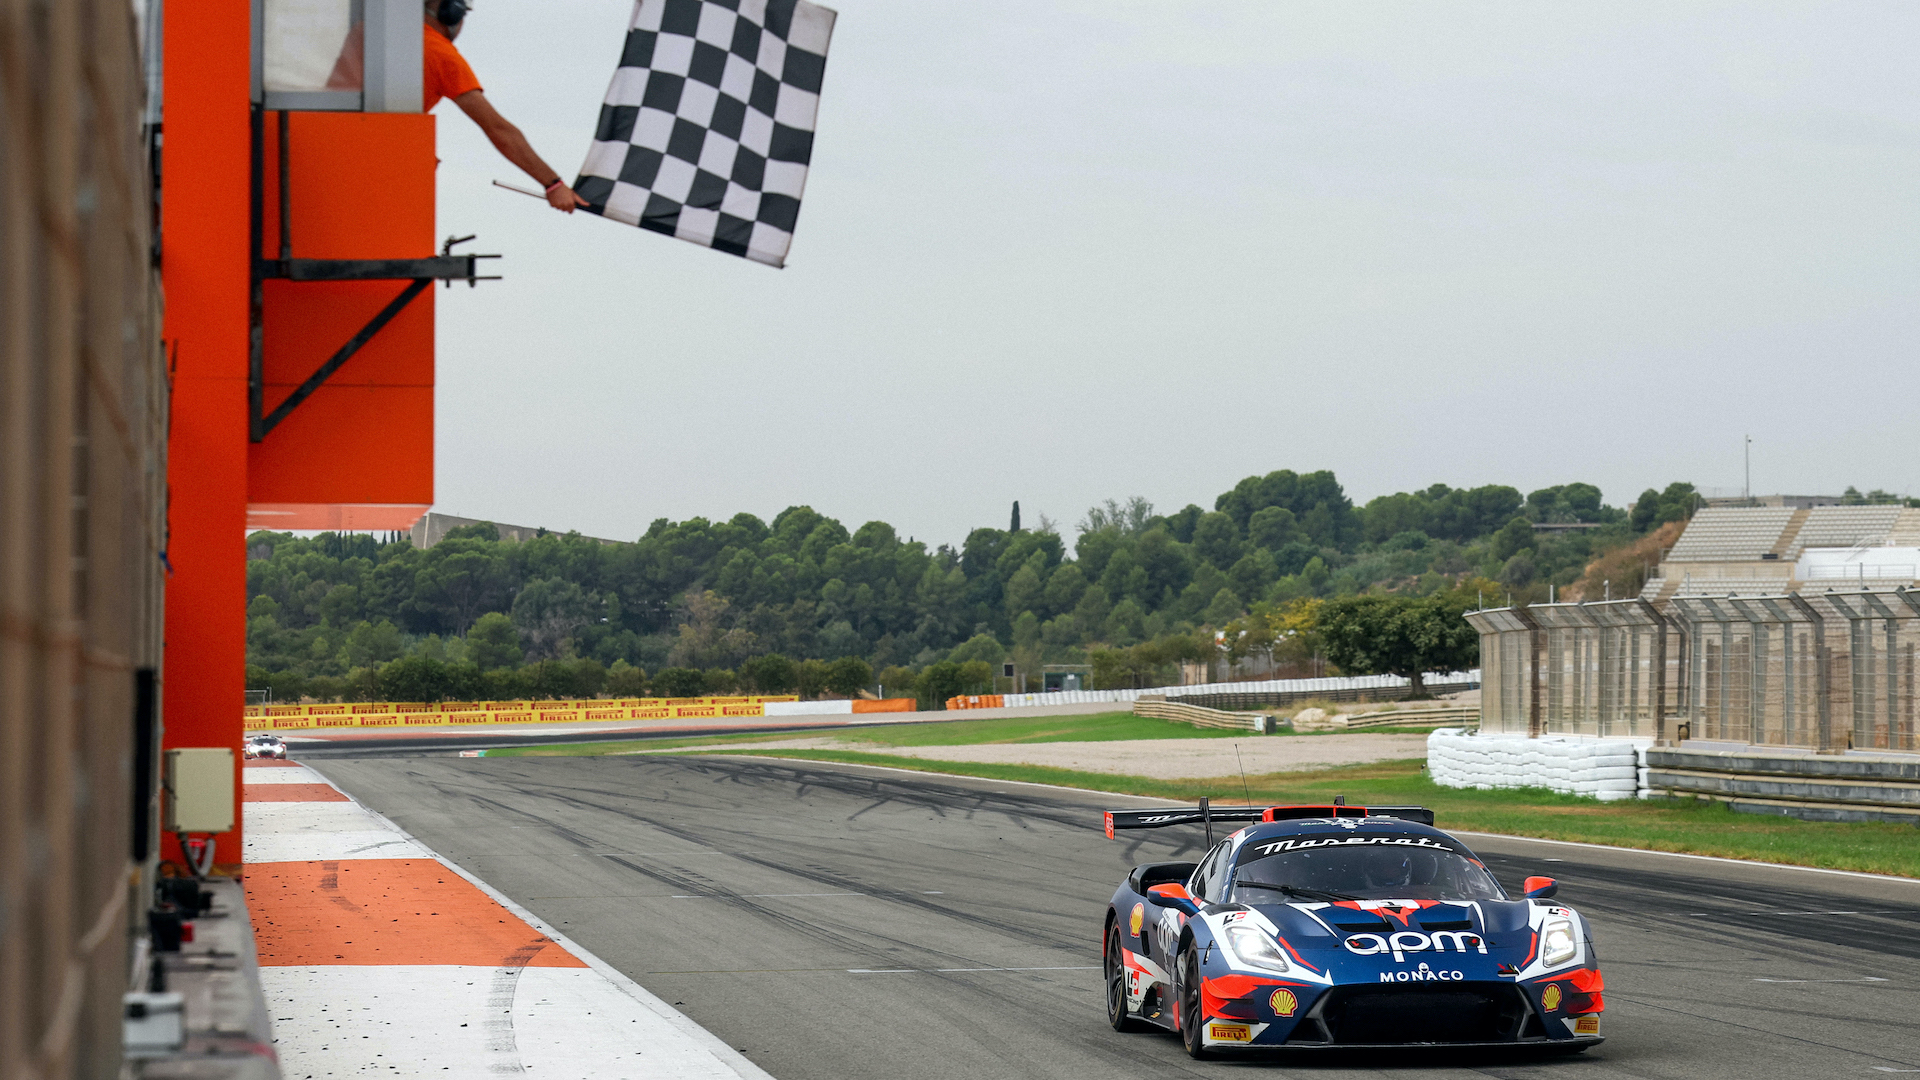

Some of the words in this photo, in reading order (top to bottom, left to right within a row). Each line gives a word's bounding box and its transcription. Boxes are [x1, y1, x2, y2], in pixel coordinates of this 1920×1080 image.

[265, 707, 302, 716] PIRELLI
[309, 706, 345, 715] PIRELLI
[352, 705, 389, 714] PIRELLI
[396, 704, 433, 713] PIRELLI
[273, 718, 309, 728] PIRELLI
[316, 717, 353, 727] PIRELLI
[361, 716, 397, 725] PIRELLI
[405, 715, 442, 724] PIRELLI
[449, 714, 487, 723] PIRELLI
[495, 713, 532, 722] PIRELLI
[540, 711, 578, 721] PIRELLI
[586, 710, 623, 719] PIRELLI
[631, 709, 669, 718] PIRELLI
[677, 707, 715, 717] PIRELLI
[723, 706, 761, 716] PIRELLI
[1254, 837, 1454, 855] Maserati
[1344, 931, 1488, 962] apm
[1379, 970, 1464, 983] MONACO
[1577, 1019, 1598, 1030] PIRELLI
[1212, 1026, 1247, 1038] PIRELLI
